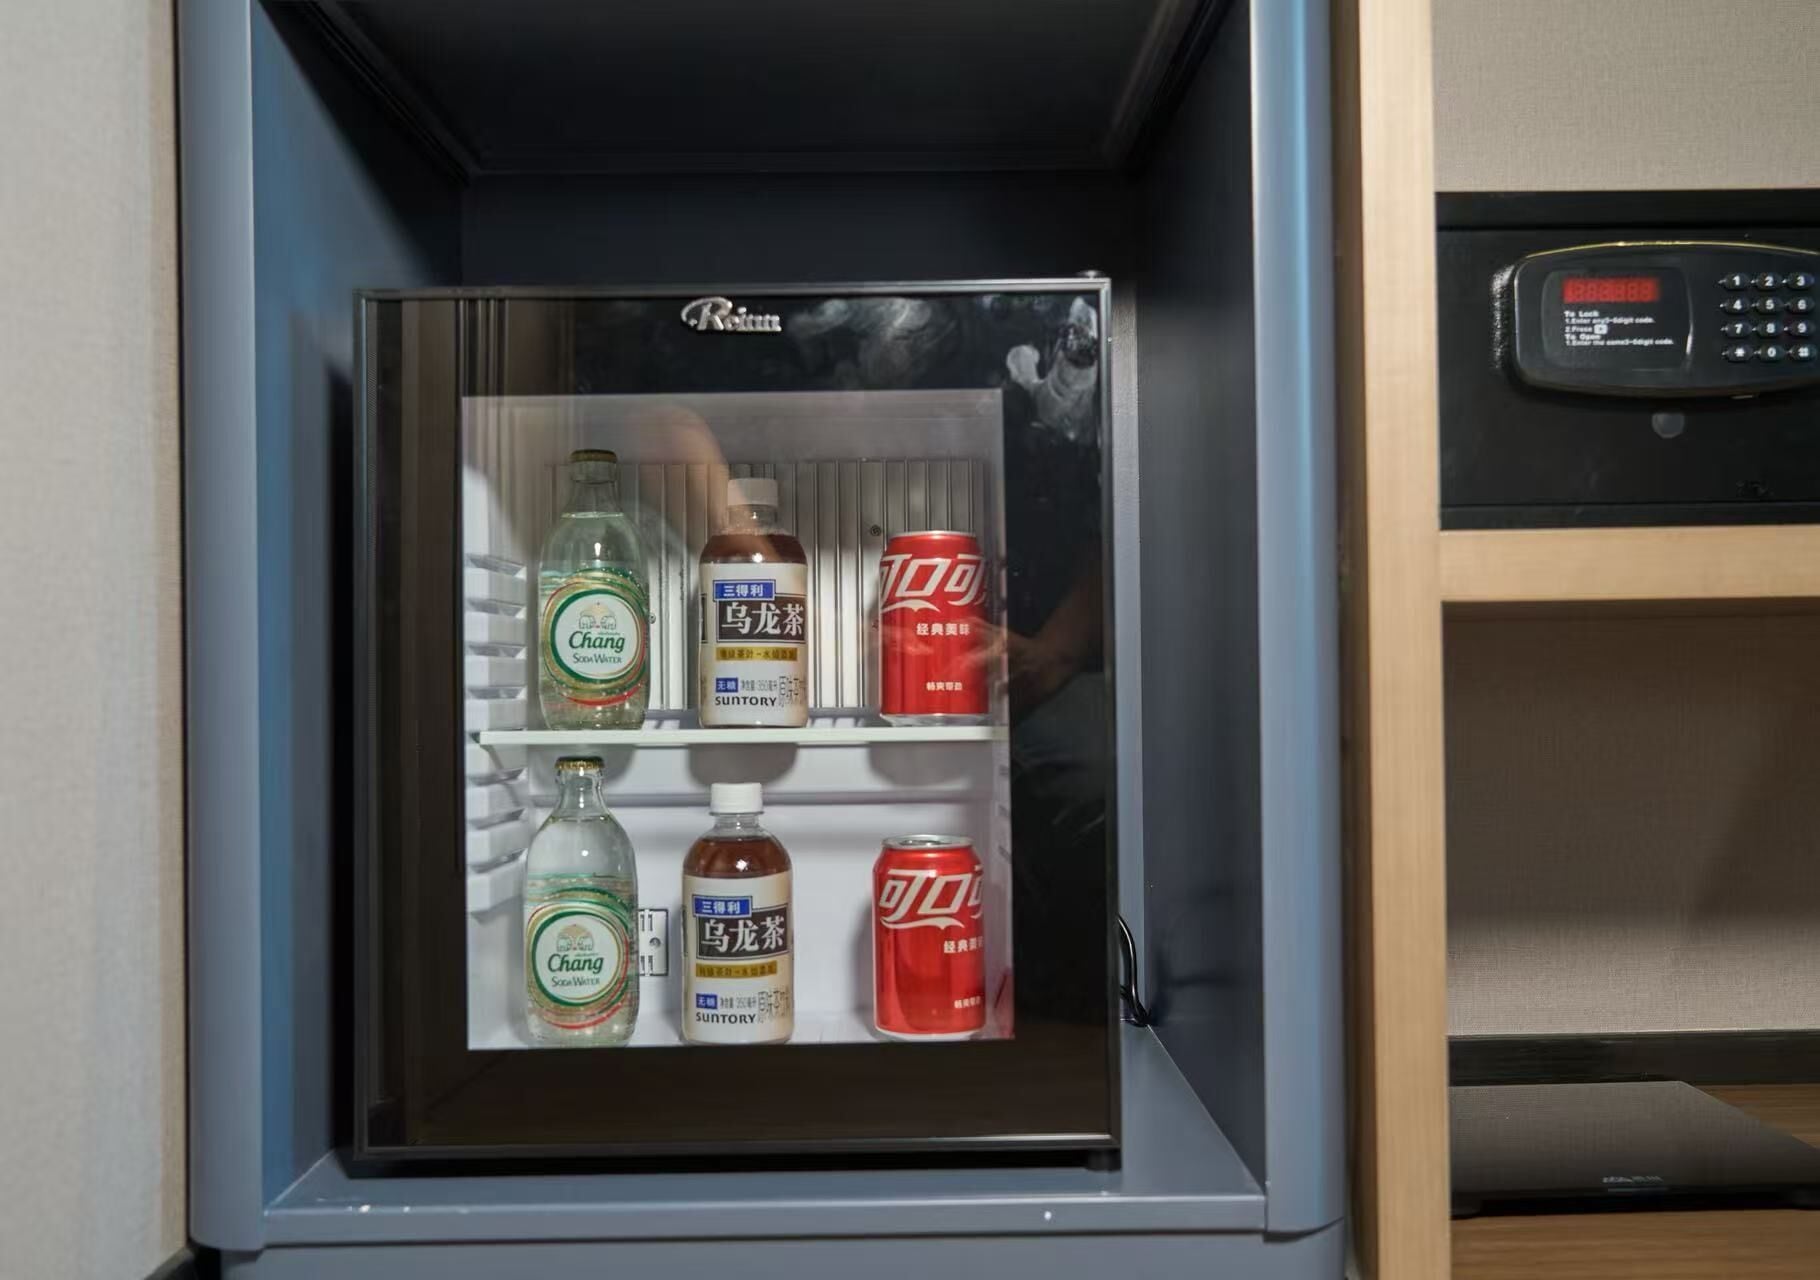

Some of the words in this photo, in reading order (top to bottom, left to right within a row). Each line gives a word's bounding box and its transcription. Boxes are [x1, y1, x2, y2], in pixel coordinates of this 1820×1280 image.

[1732, 275, 1740, 286] 1
[1764, 276, 1774, 287] 2
[1796, 276, 1806, 287] 3
[1733, 299, 1742, 310] 4
[1765, 299, 1775, 310] 5
[1797, 299, 1807, 310] 6
[1578, 310, 1600, 318] Lock
[1734, 323, 1743, 334] 7
[1766, 323, 1775, 333] 8
[1797, 323, 1807, 333] 9
[1767, 347, 1777, 358] 0
[723, 583, 764, 597] 三得利
[720, 601, 805, 637] 乌龙茶
[916, 622, 971, 636] 经典美味
[568, 630, 626, 654] Chang
[701, 900, 741, 915] 三得利
[700, 915, 786, 953] 乌龙茶
[547, 953, 605, 974] Chang
